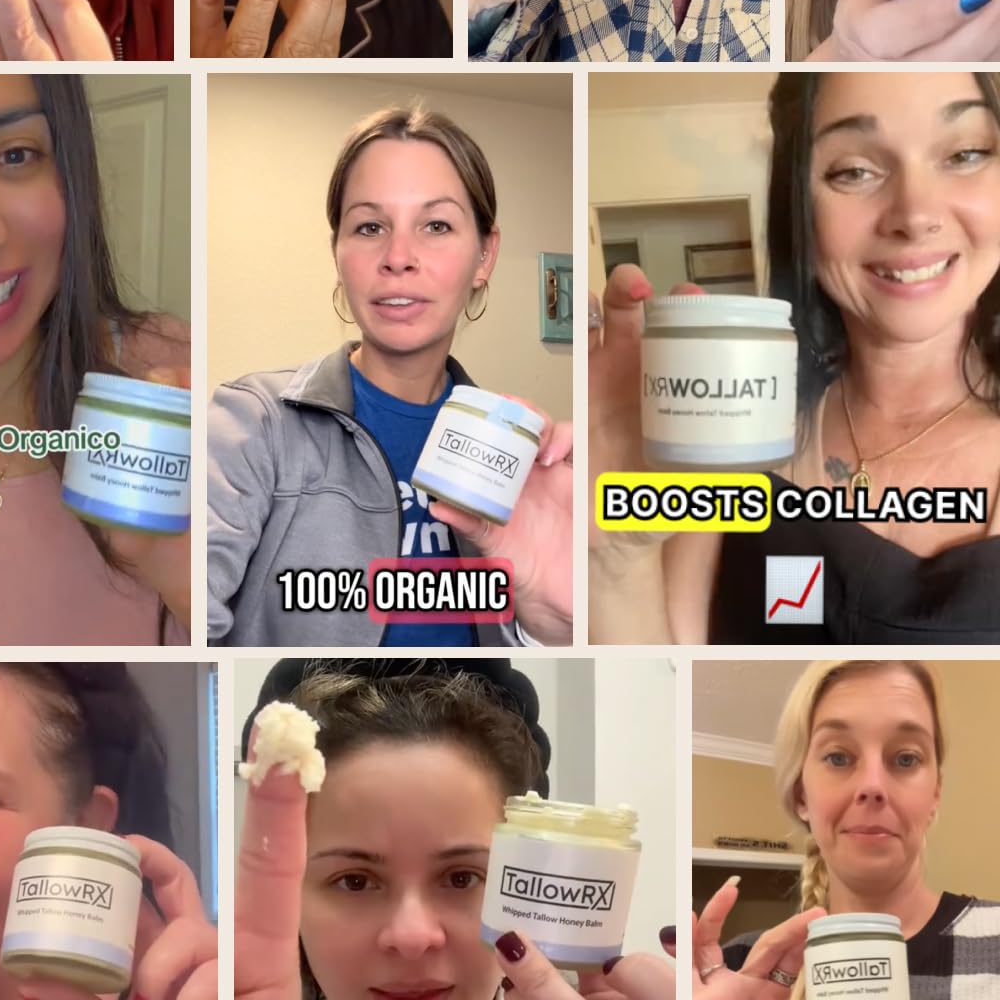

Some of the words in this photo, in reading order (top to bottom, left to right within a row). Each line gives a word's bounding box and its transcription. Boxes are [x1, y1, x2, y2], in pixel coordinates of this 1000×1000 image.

[444, 433, 518, 474] TallowRX
[21, 879, 109, 906] TallowRX
[506, 872, 613, 910] TallowRX
[502, 905, 532, 920] Whipped
[532, 912, 558, 923] Tallow
[560, 917, 585, 929] Honey
[586, 919, 603, 928] Balm
